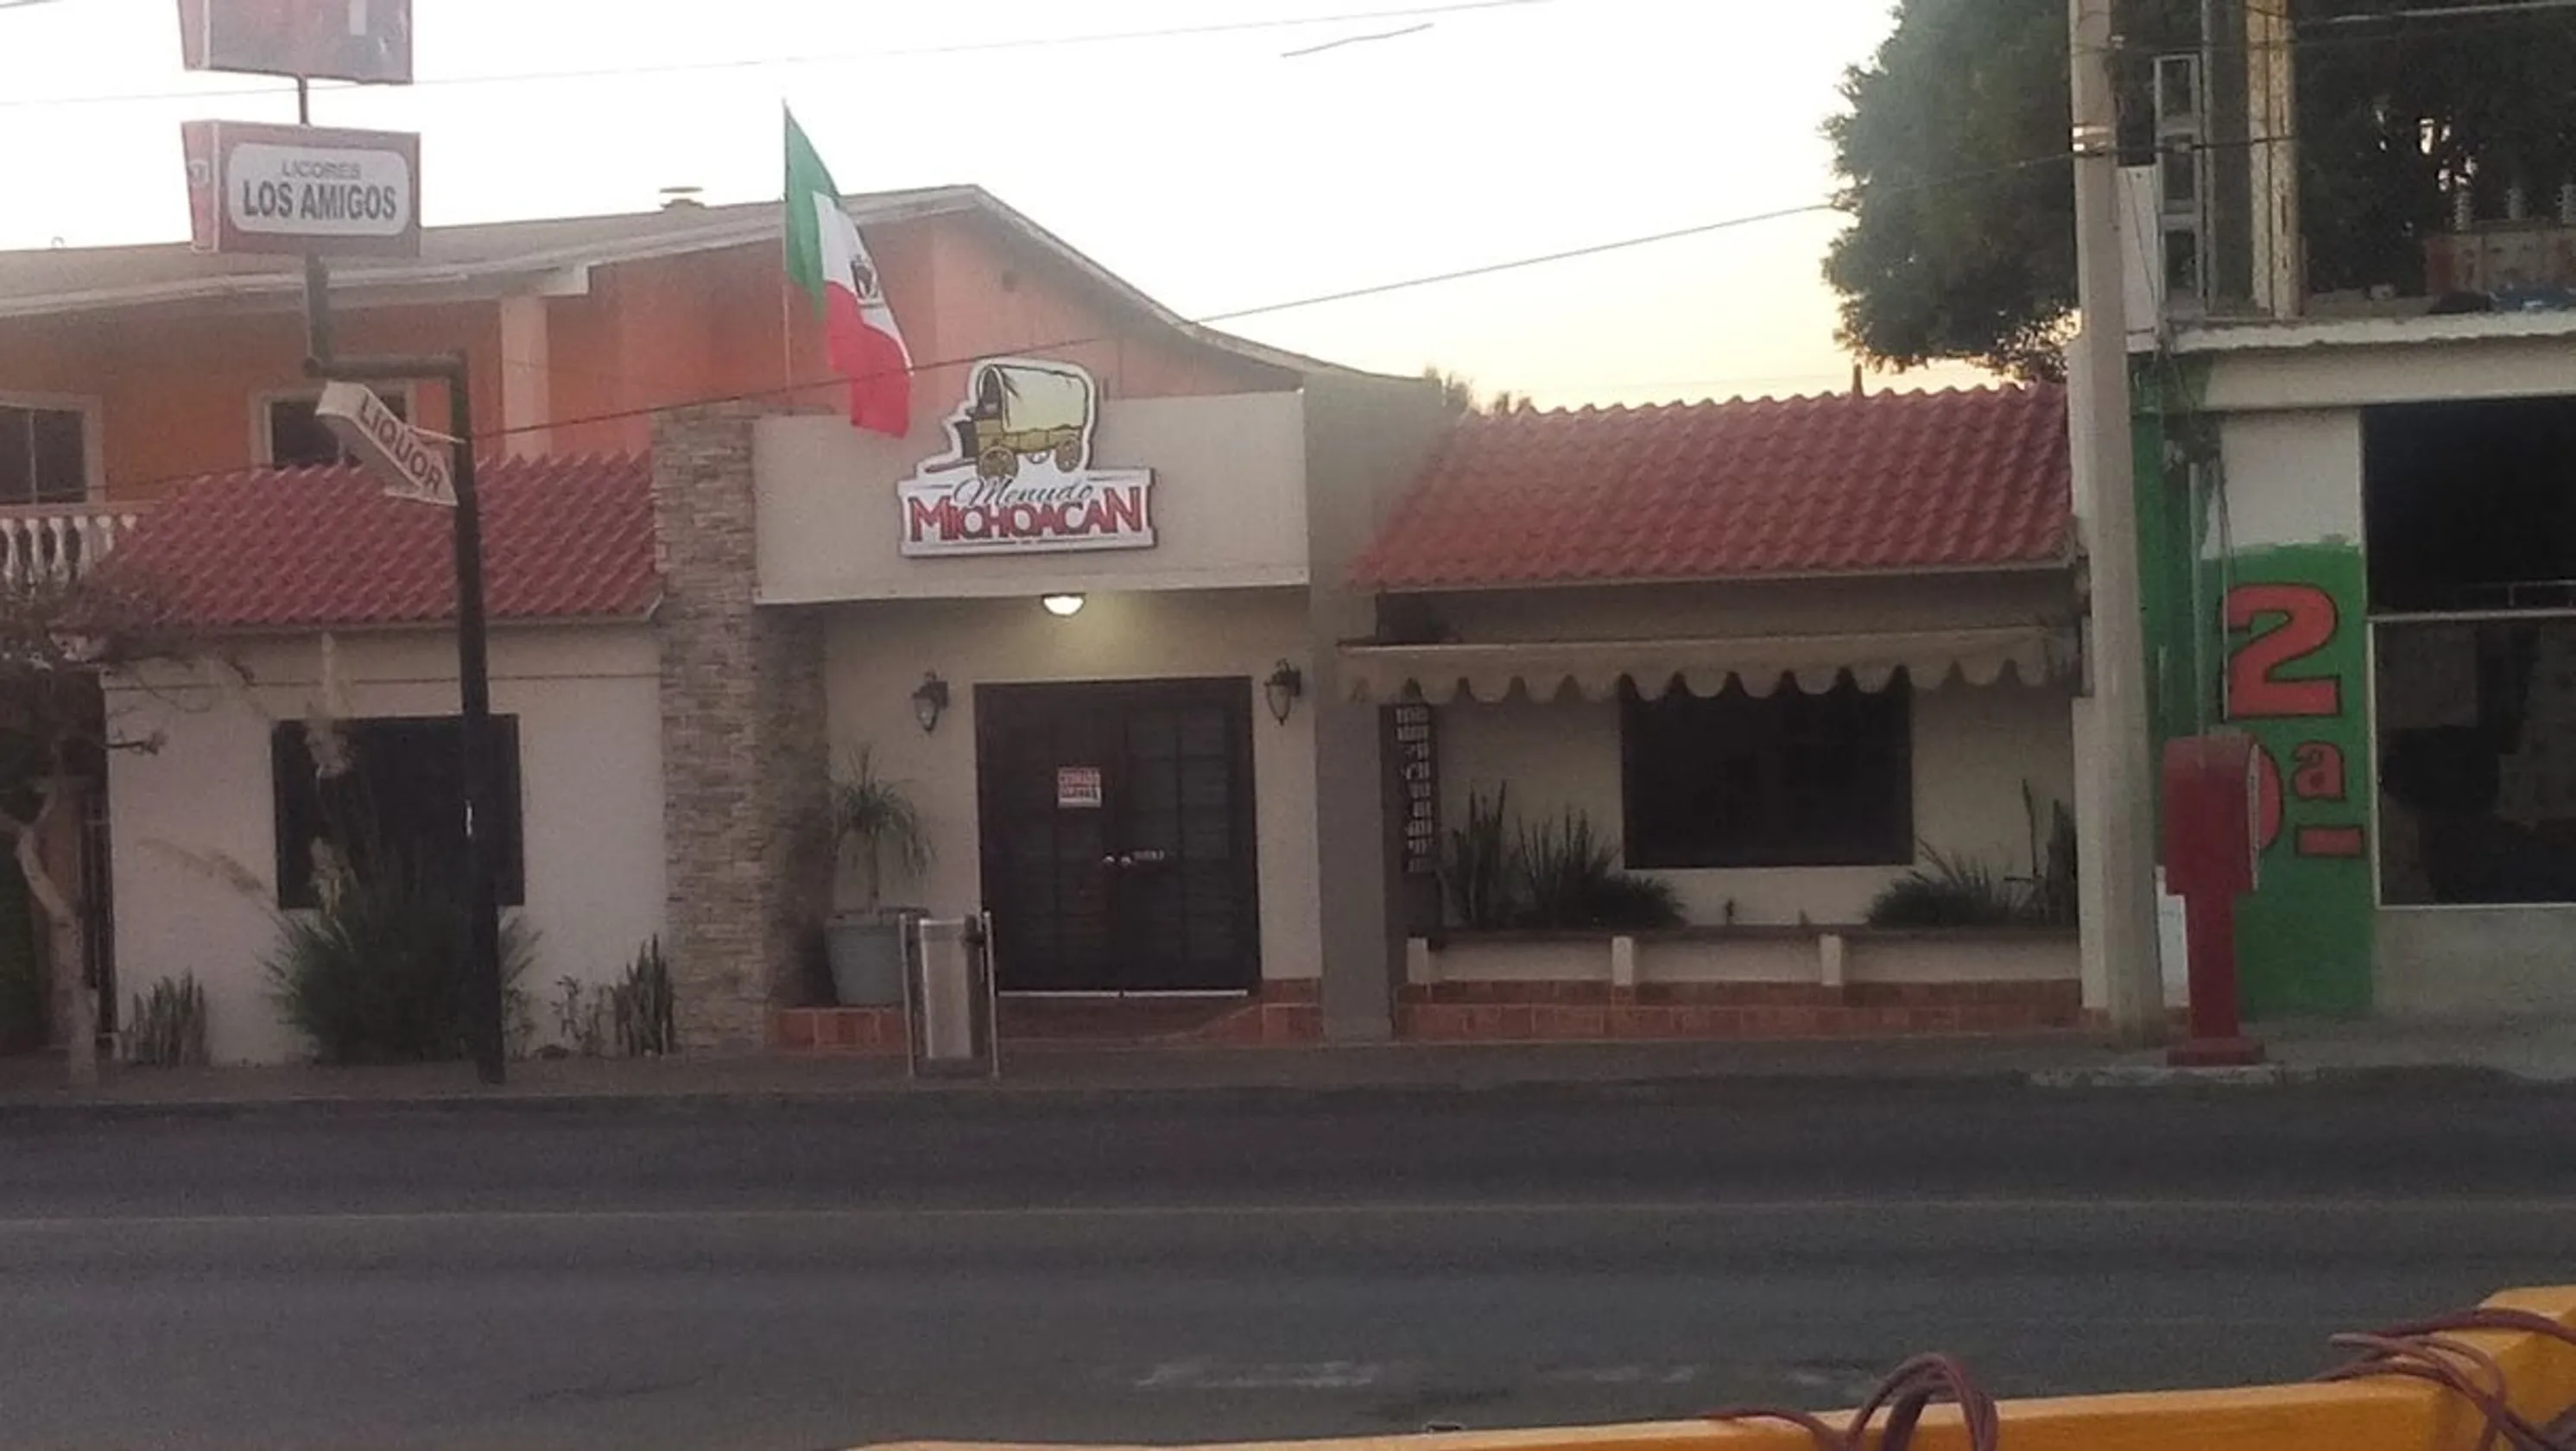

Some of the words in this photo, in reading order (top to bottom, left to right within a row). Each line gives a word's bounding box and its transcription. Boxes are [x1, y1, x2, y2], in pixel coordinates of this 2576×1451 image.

[282, 158, 362, 181] LICORES
[243, 180, 294, 219] LOS
[300, 182, 398, 221] AMIGOS
[358, 395, 444, 495] LIQUOR
[908, 485, 1142, 542] MICHOACAN
[952, 476, 1094, 507] Menudo
[2221, 583, 2341, 718] 2
